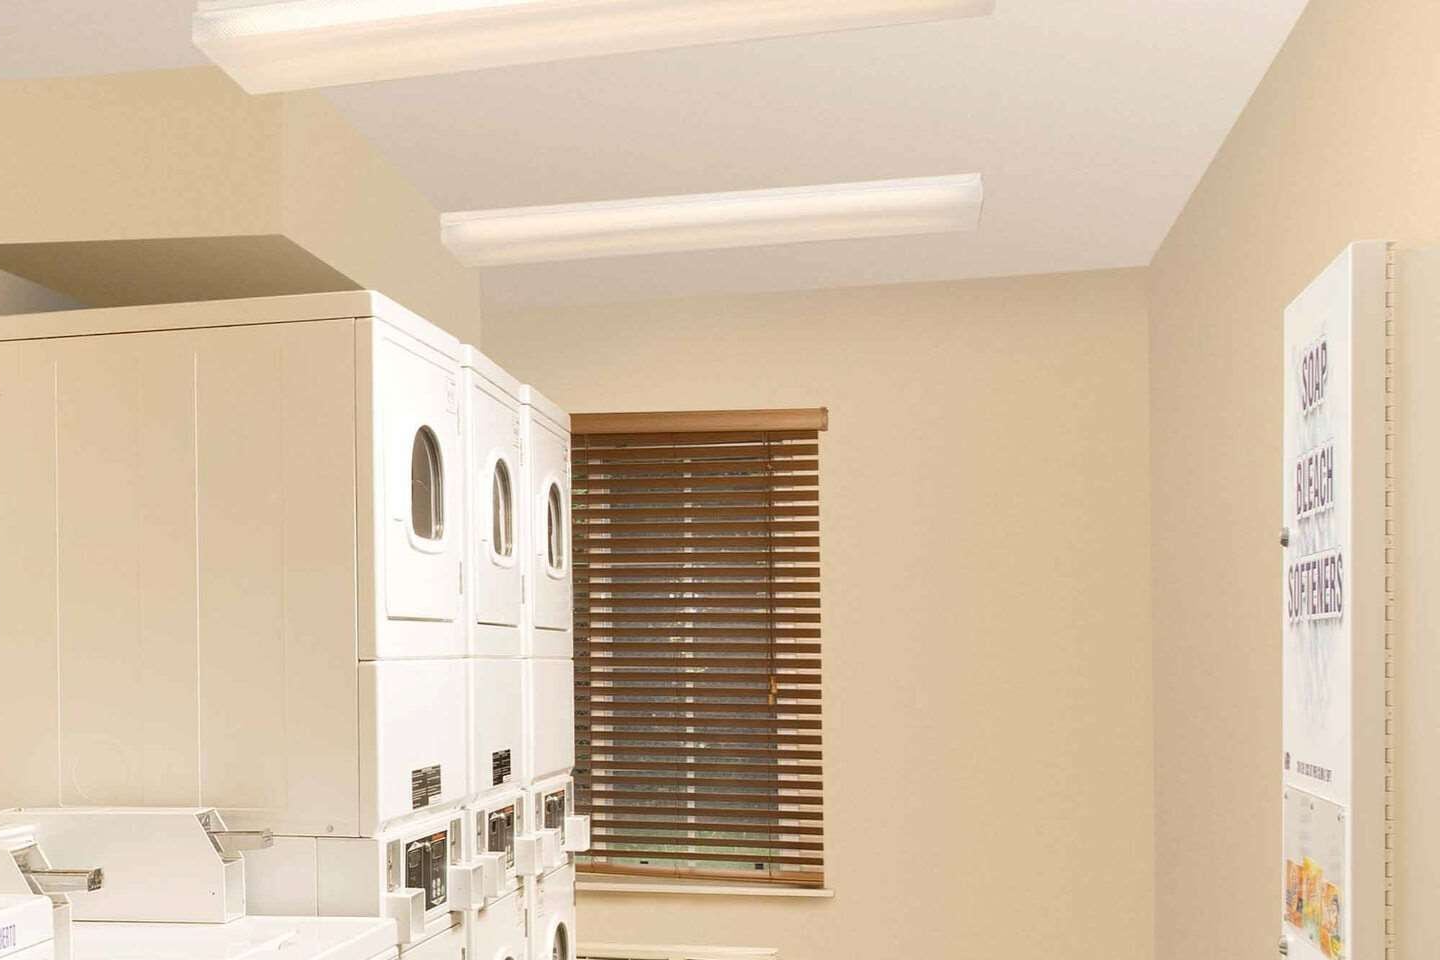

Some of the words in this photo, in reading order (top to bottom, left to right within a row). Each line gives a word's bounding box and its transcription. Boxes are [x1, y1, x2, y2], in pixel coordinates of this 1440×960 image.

[1302, 341, 1328, 411] SOAP
[1297, 447, 1334, 515] BLEACH
[1288, 552, 1343, 618] SOFTENERS
